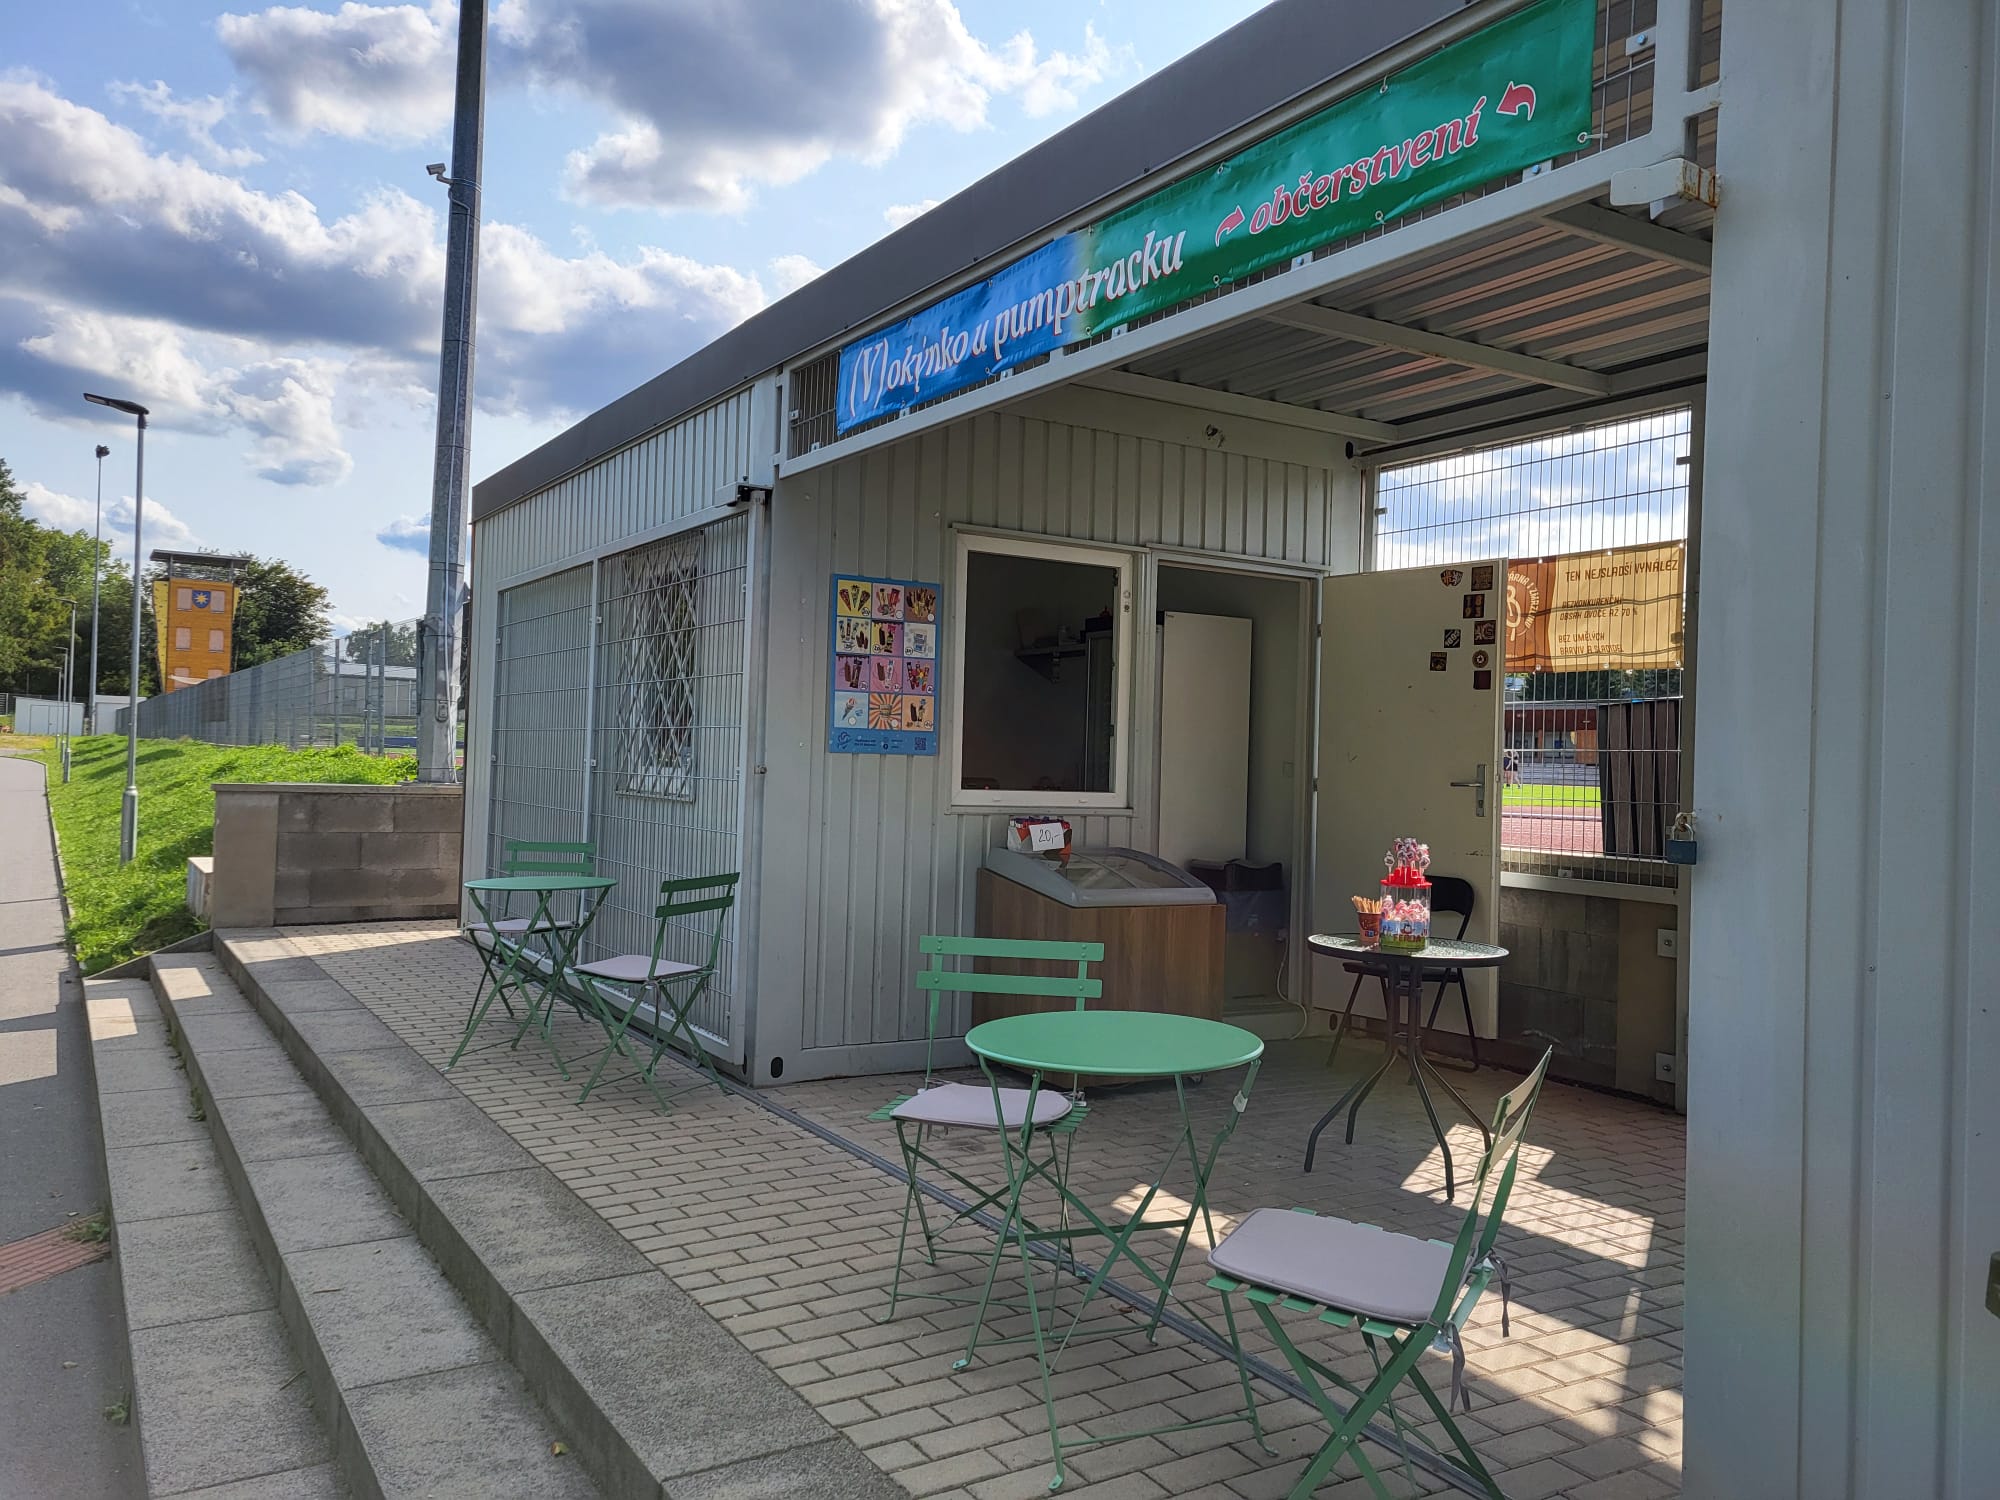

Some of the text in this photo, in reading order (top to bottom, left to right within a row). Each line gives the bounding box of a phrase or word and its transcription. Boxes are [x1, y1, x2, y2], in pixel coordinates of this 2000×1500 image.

[1249, 96, 1488, 235] občerstvení
[850, 229, 1189, 417] (V)okýnko u pumptracku
[1507, 570, 1530, 586] ÁRNA
[1565, 558, 1678, 582] TEN NEJSLADŠÍ VYNÁLEZ
[1560, 610, 1582, 621] OBSAH
[1584, 608, 1606, 619] OVOCE
[1609, 607, 1619, 617] AŽ
[1621, 608, 1631, 617] 70
[1558, 630, 1605, 643] BEZ UMĚLÝCH
[1560, 645, 1585, 656] BARVIV
[1038, 828, 1062, 845] 20,-
